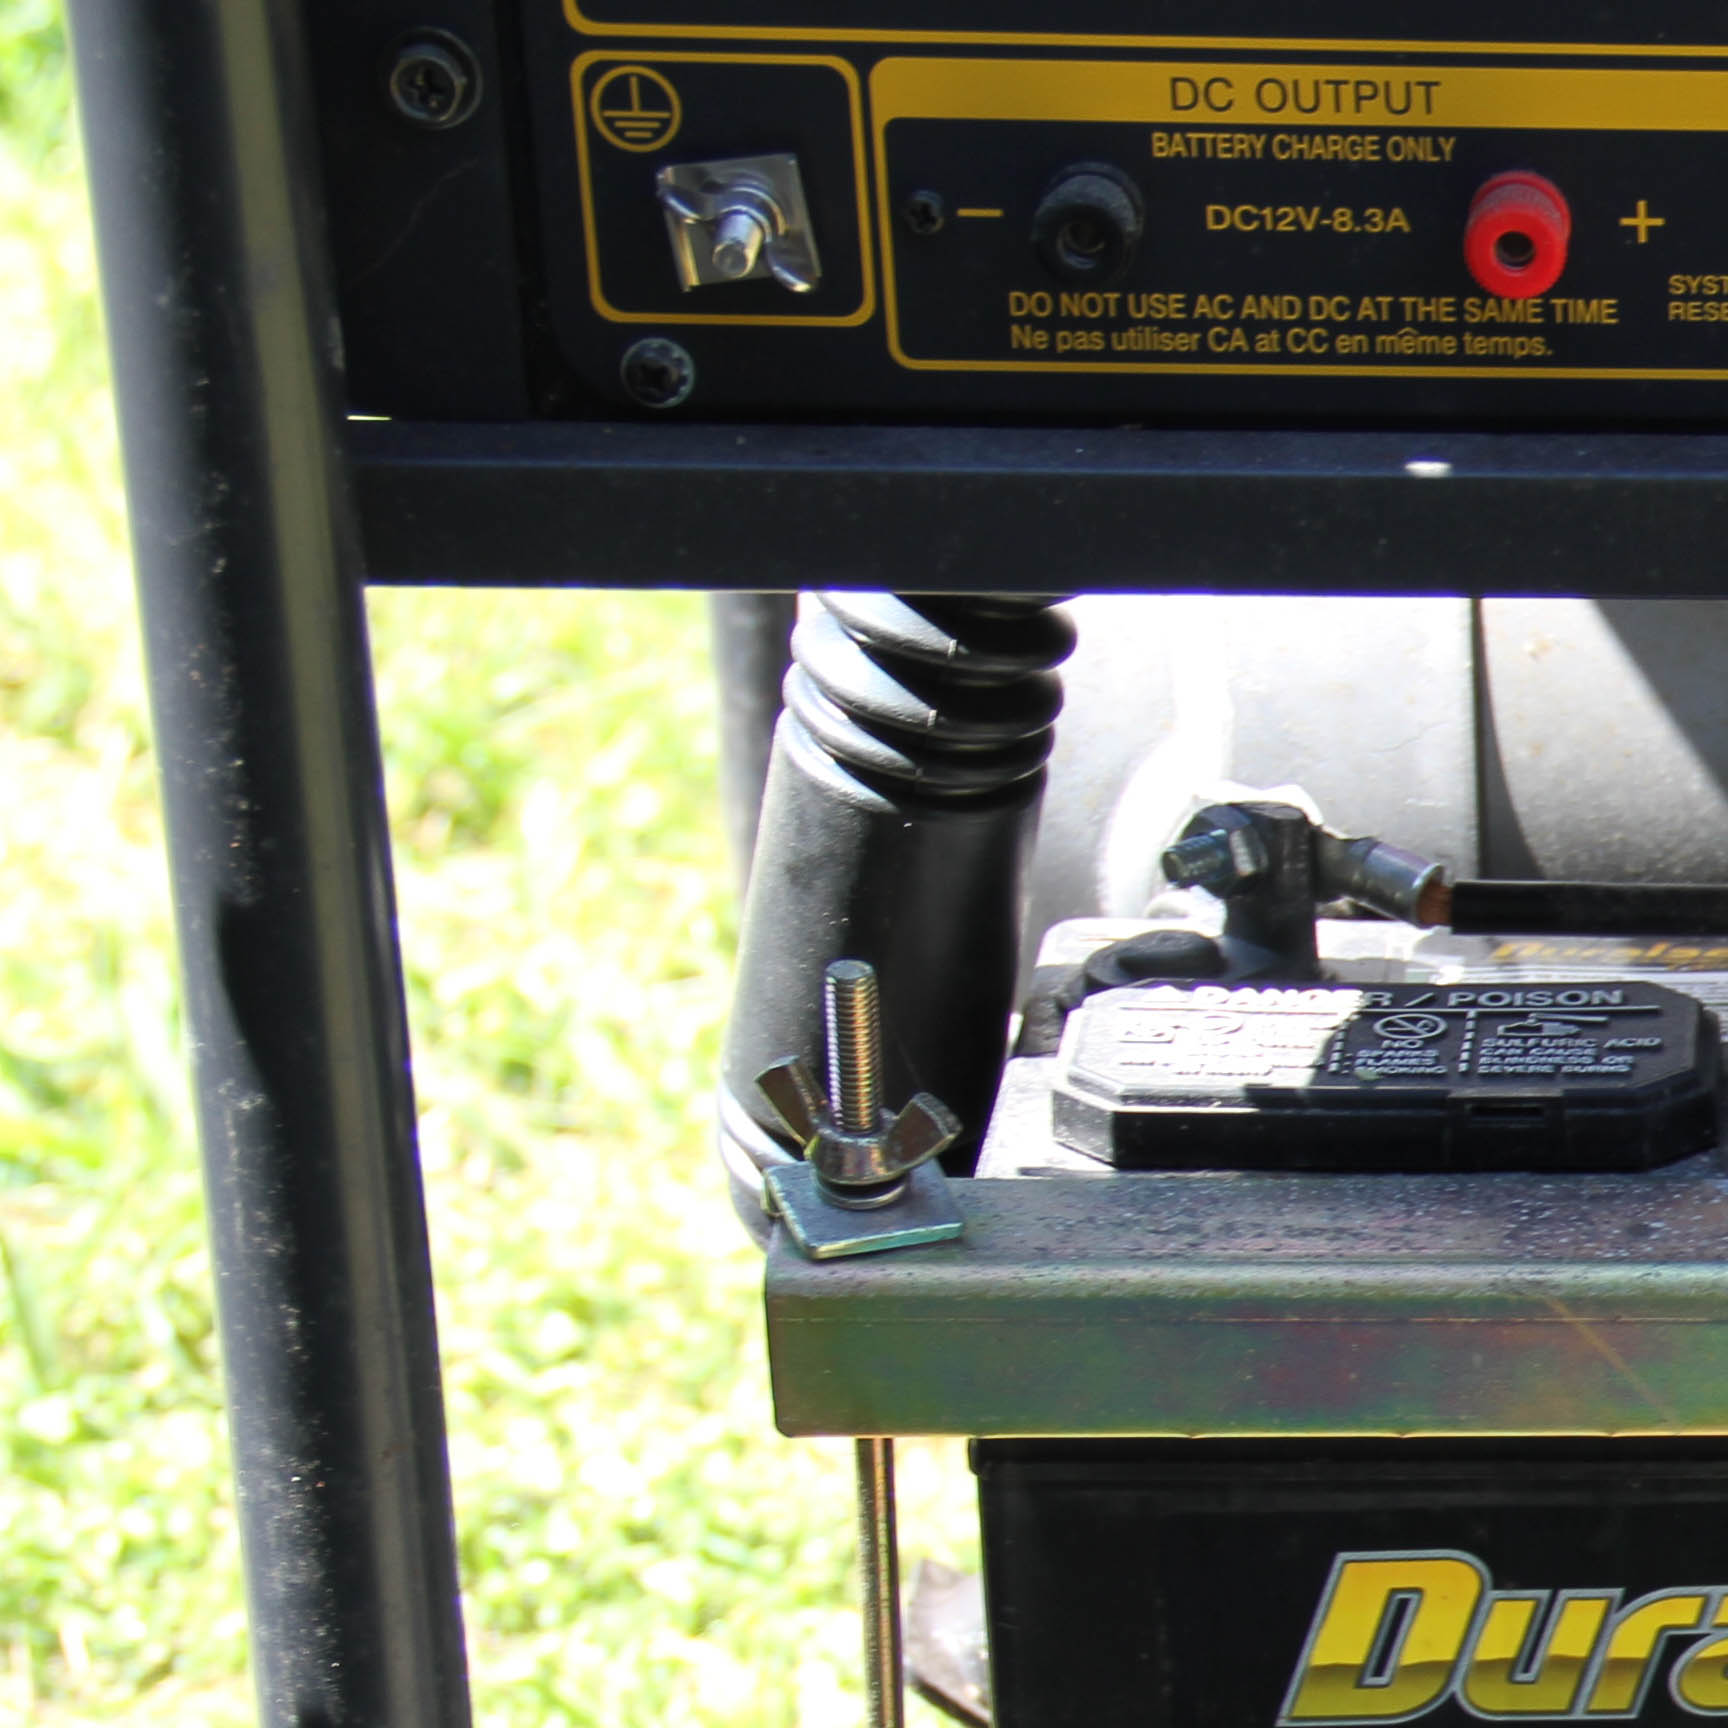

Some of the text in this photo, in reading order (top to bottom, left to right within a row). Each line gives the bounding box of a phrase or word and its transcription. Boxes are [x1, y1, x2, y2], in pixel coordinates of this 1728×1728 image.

[1169, 77, 1442, 115] DC OUTPUT
[1151, 131, 1457, 162] BATTERY CHARGE ONLY
[1205, 204, 1412, 233] DC12V-8.3A
[1008, 291, 1620, 324] DO NOT USE AC AND DC AT THE SAME TIME
[1010, 323, 1050, 350] Ne
[1055, 329, 1105, 354] pas
[1110, 326, 1202, 352] utiliser
[1206, 326, 1249, 353] CA
[1285, 327, 1329, 354] CC
[1334, 332, 1370, 355] en
[1374, 326, 1458, 355] même
[1462, 330, 1554, 359] temps.
[1446, 989, 1625, 1008] POISON
[1380, 1038, 1425, 1049] NO
[1480, 1037, 1663, 1049] SULFURIC ACID
